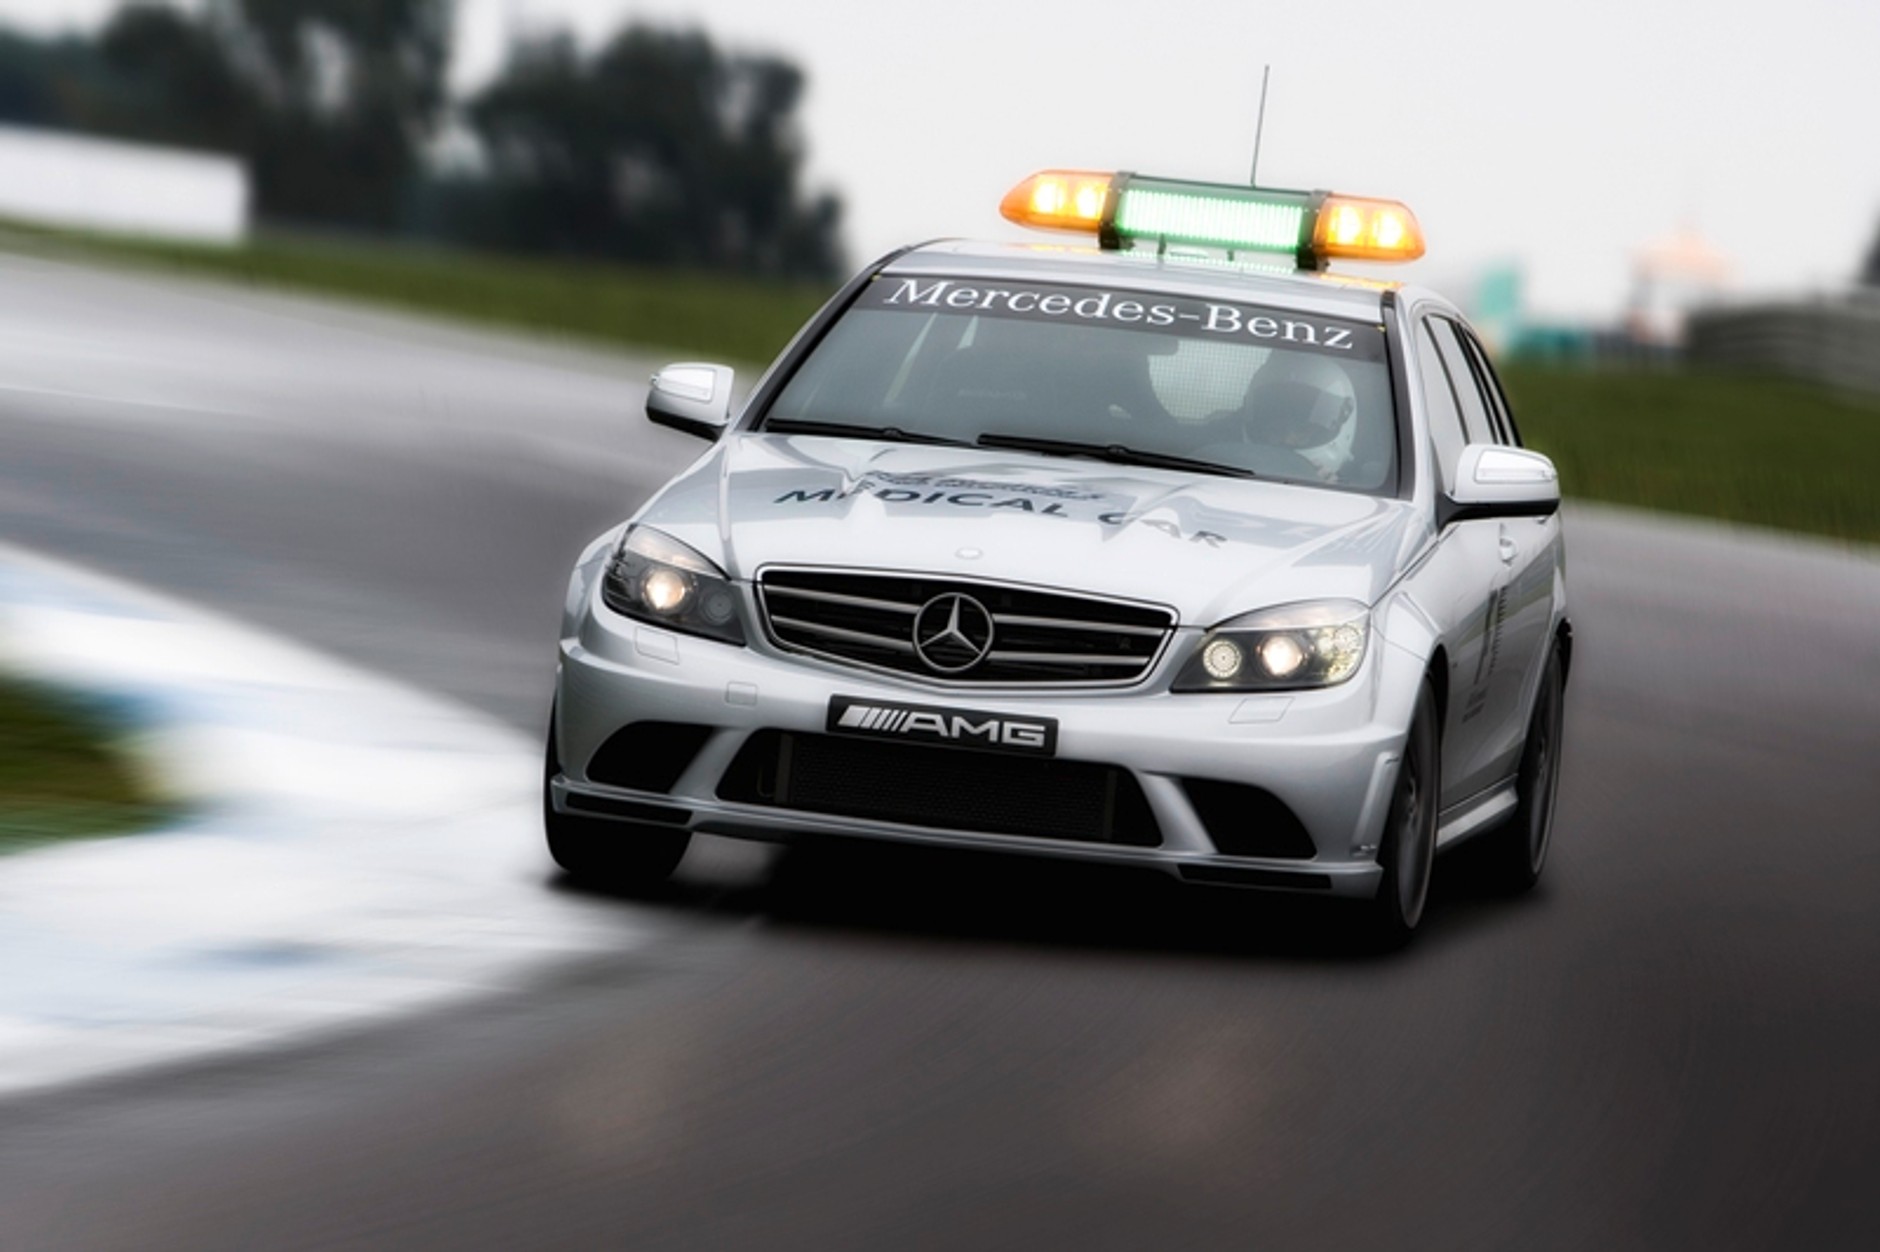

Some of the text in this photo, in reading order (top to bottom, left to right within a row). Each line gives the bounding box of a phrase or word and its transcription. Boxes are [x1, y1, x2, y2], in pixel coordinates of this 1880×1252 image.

[883, 278, 1354, 350] Mercedes-Benz
[773, 487, 1069, 518] MDICAL
[900, 711, 1046, 747] AMG
